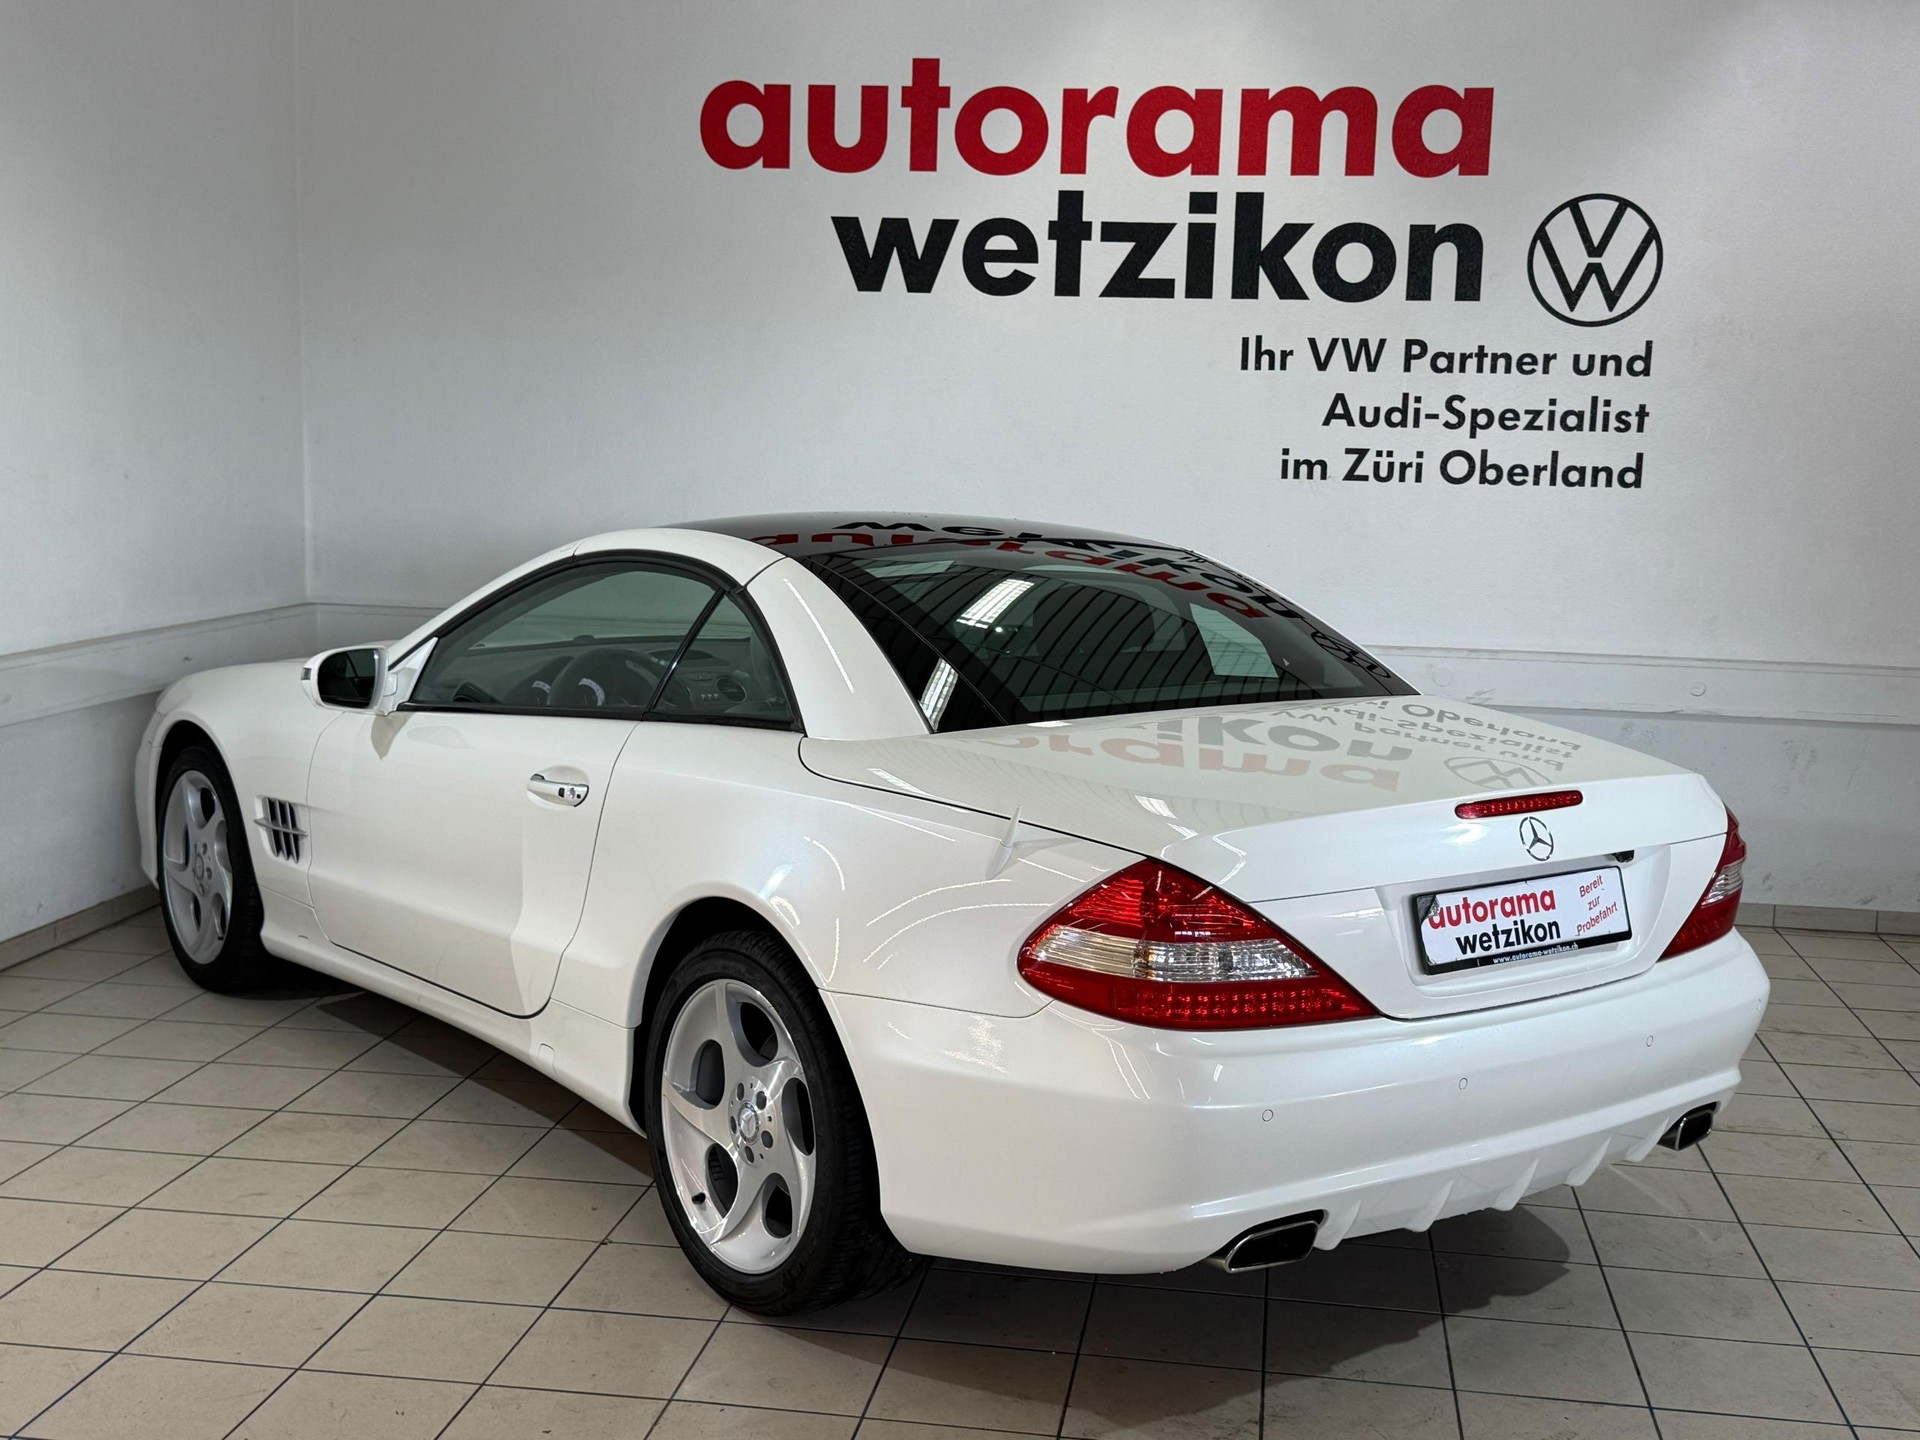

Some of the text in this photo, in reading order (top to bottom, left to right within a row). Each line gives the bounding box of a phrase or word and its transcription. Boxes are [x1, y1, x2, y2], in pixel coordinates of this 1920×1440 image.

[700, 58, 1495, 178] autorama
[831, 190, 1484, 302] wetzikon
[1240, 335, 1654, 378] Ihr VW Partner und
[1322, 392, 1650, 439] Audi-Spezialist
[1280, 447, 1644, 489] im Züri Oberland
[1579, 875, 1603, 898] Bereit
[1588, 896, 1600, 911] zur
[1428, 889, 1556, 929] autorama
[1576, 901, 1618, 936] Probefahrt
[1455, 919, 1561, 955] wetzikon
[1493, 942, 1579, 964] www.autorama-wetzikon.ch
